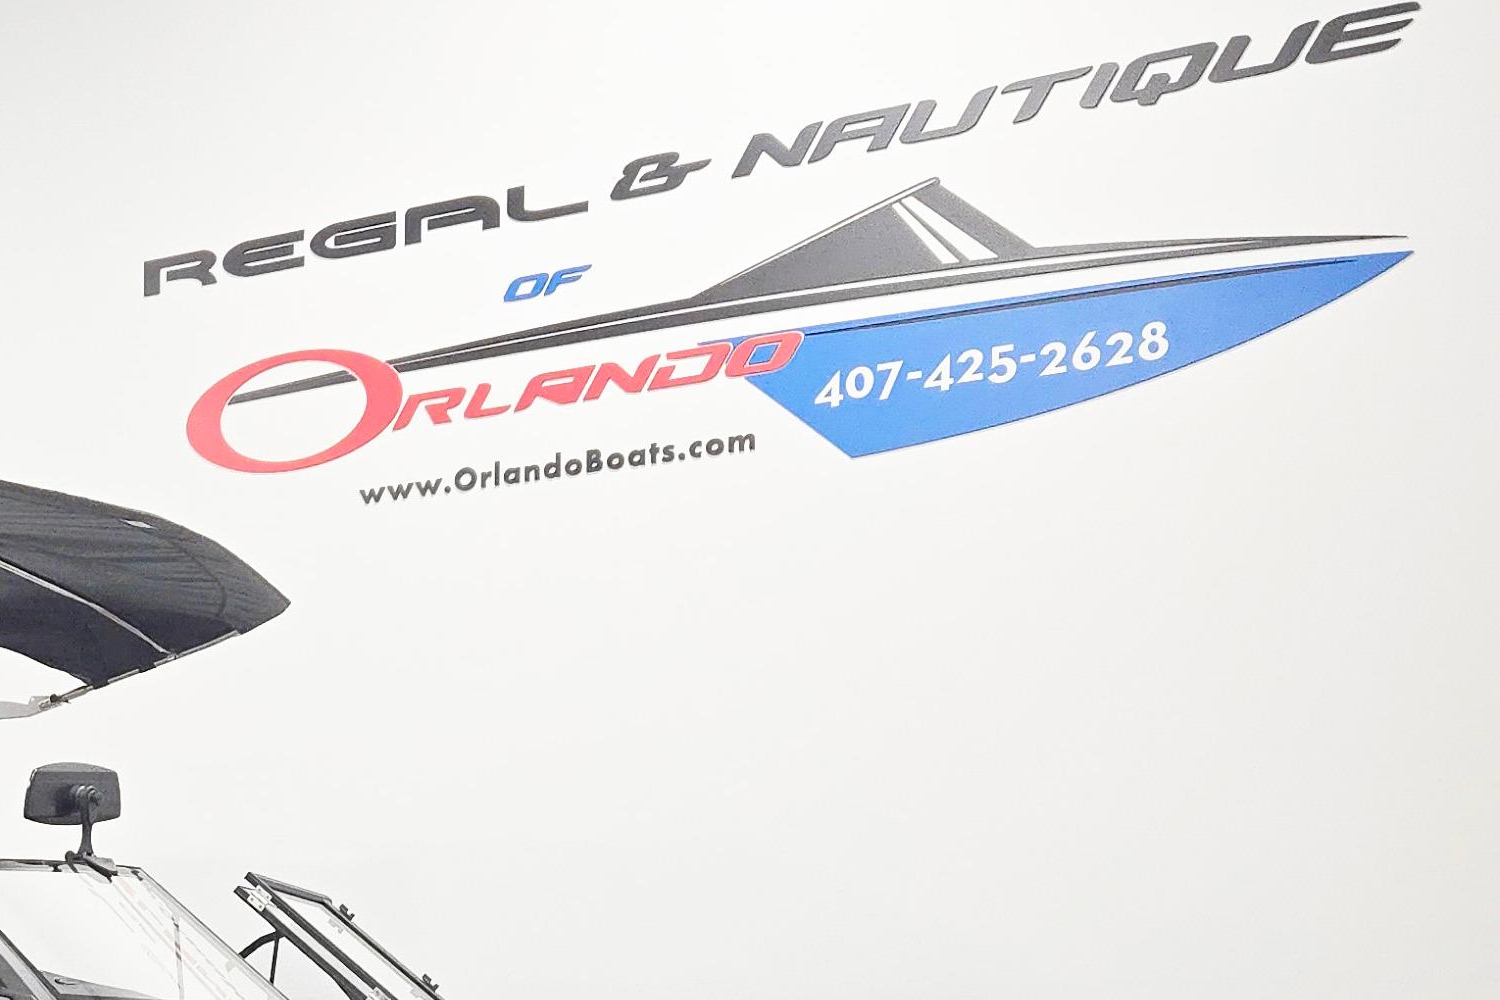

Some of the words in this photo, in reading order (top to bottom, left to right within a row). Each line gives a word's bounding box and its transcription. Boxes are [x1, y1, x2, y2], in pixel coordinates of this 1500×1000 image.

[143, 185, 589, 297] REGAL
[610, 151, 711, 200] &
[731, 1, 1421, 179] NAUTIQUE
[503, 263, 592, 302] OF
[813, 320, 1170, 408] 407-425-2628
[359, 432, 757, 505] www.OrlandoBoats.com
